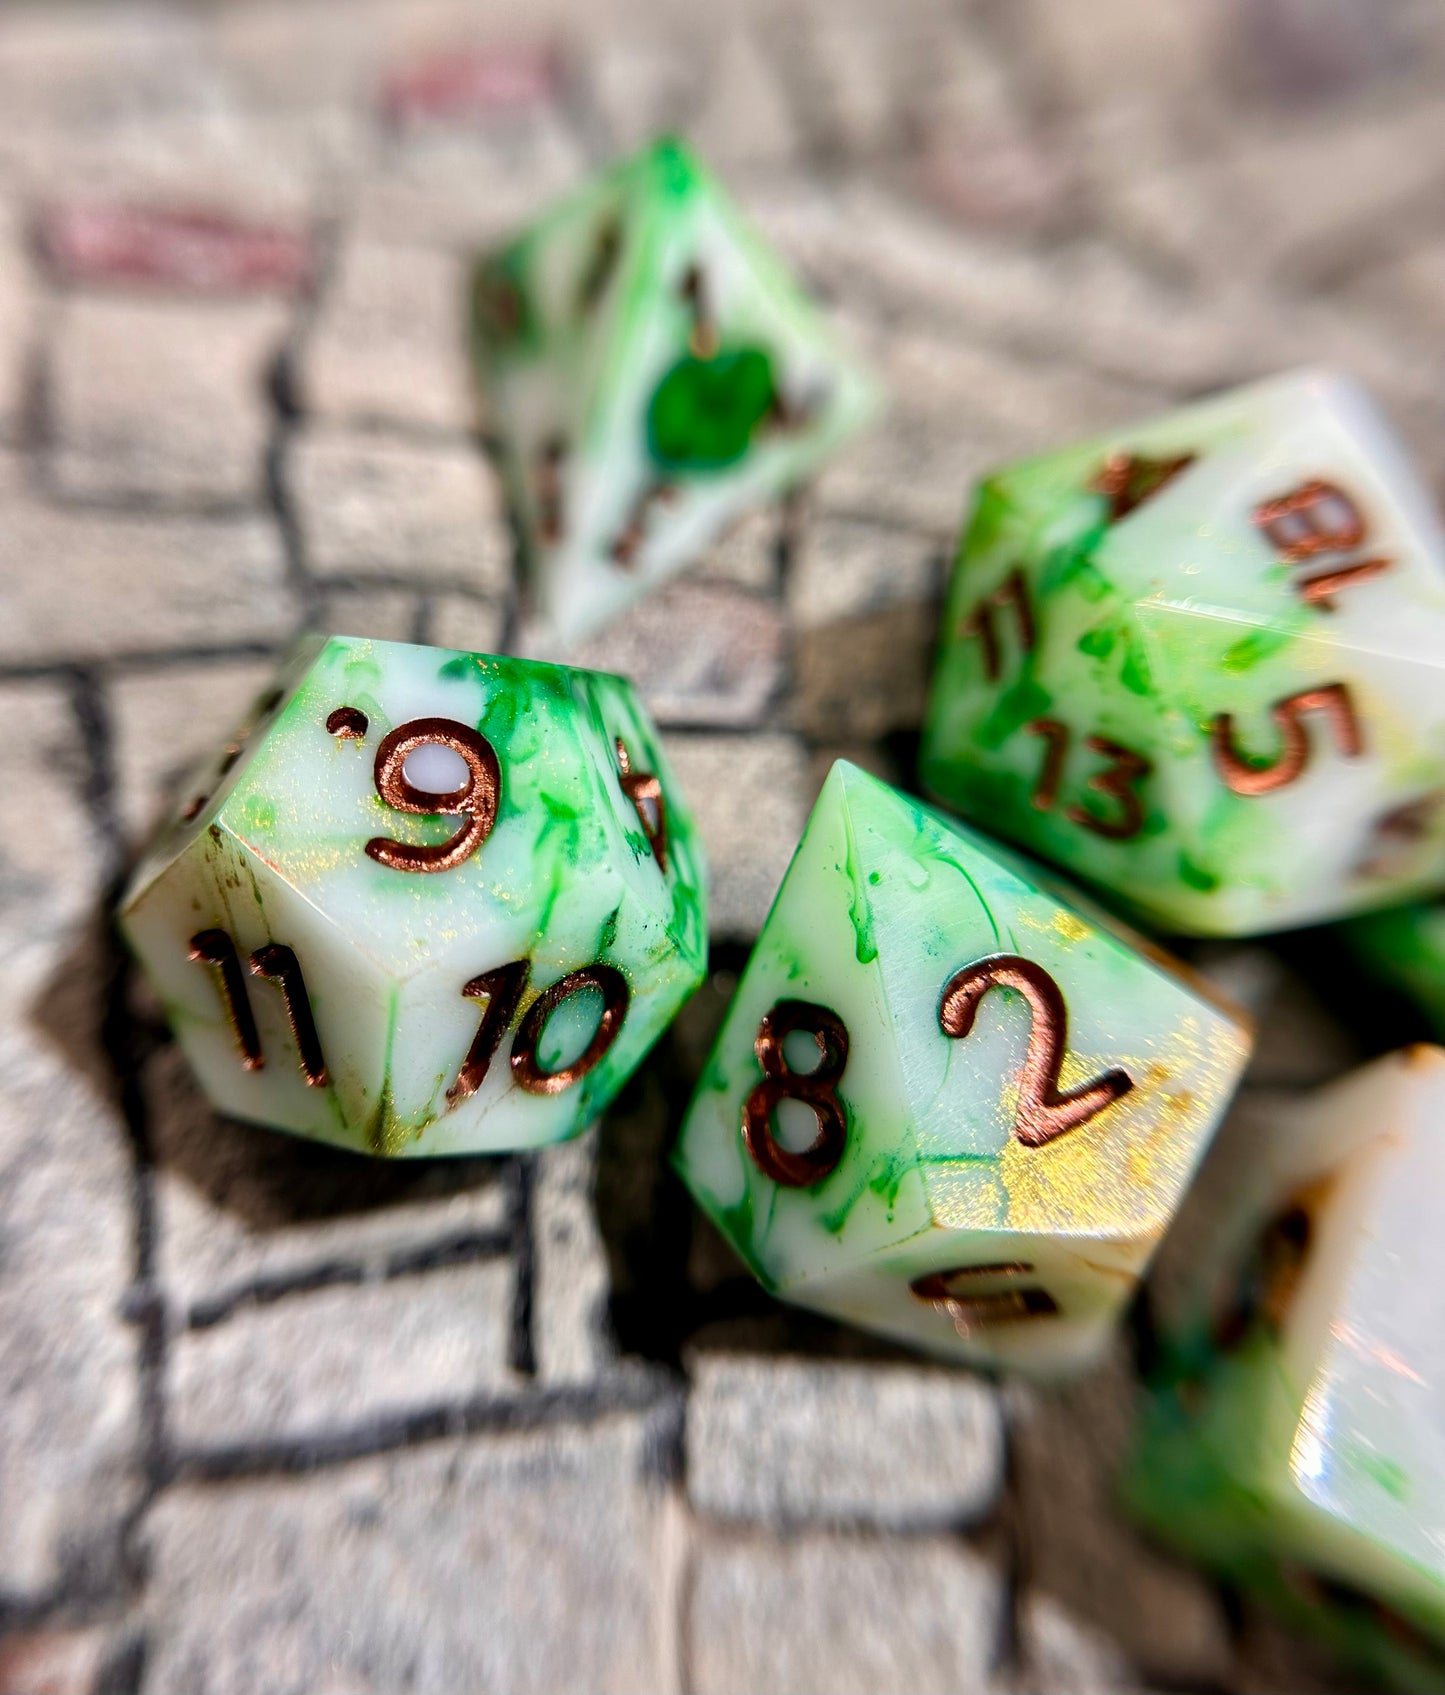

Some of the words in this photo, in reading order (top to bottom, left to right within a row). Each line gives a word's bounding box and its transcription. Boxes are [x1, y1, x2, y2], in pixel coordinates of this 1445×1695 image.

[1251, 480, 1392, 611] 18
[1026, 720, 1151, 840] 13
[1212, 683, 1363, 796] 5
[187, 929, 327, 1088] 11
[446, 959, 630, 1108] 10
[939, 952, 1134, 1148] 2
[742, 1000, 849, 1187] 8
